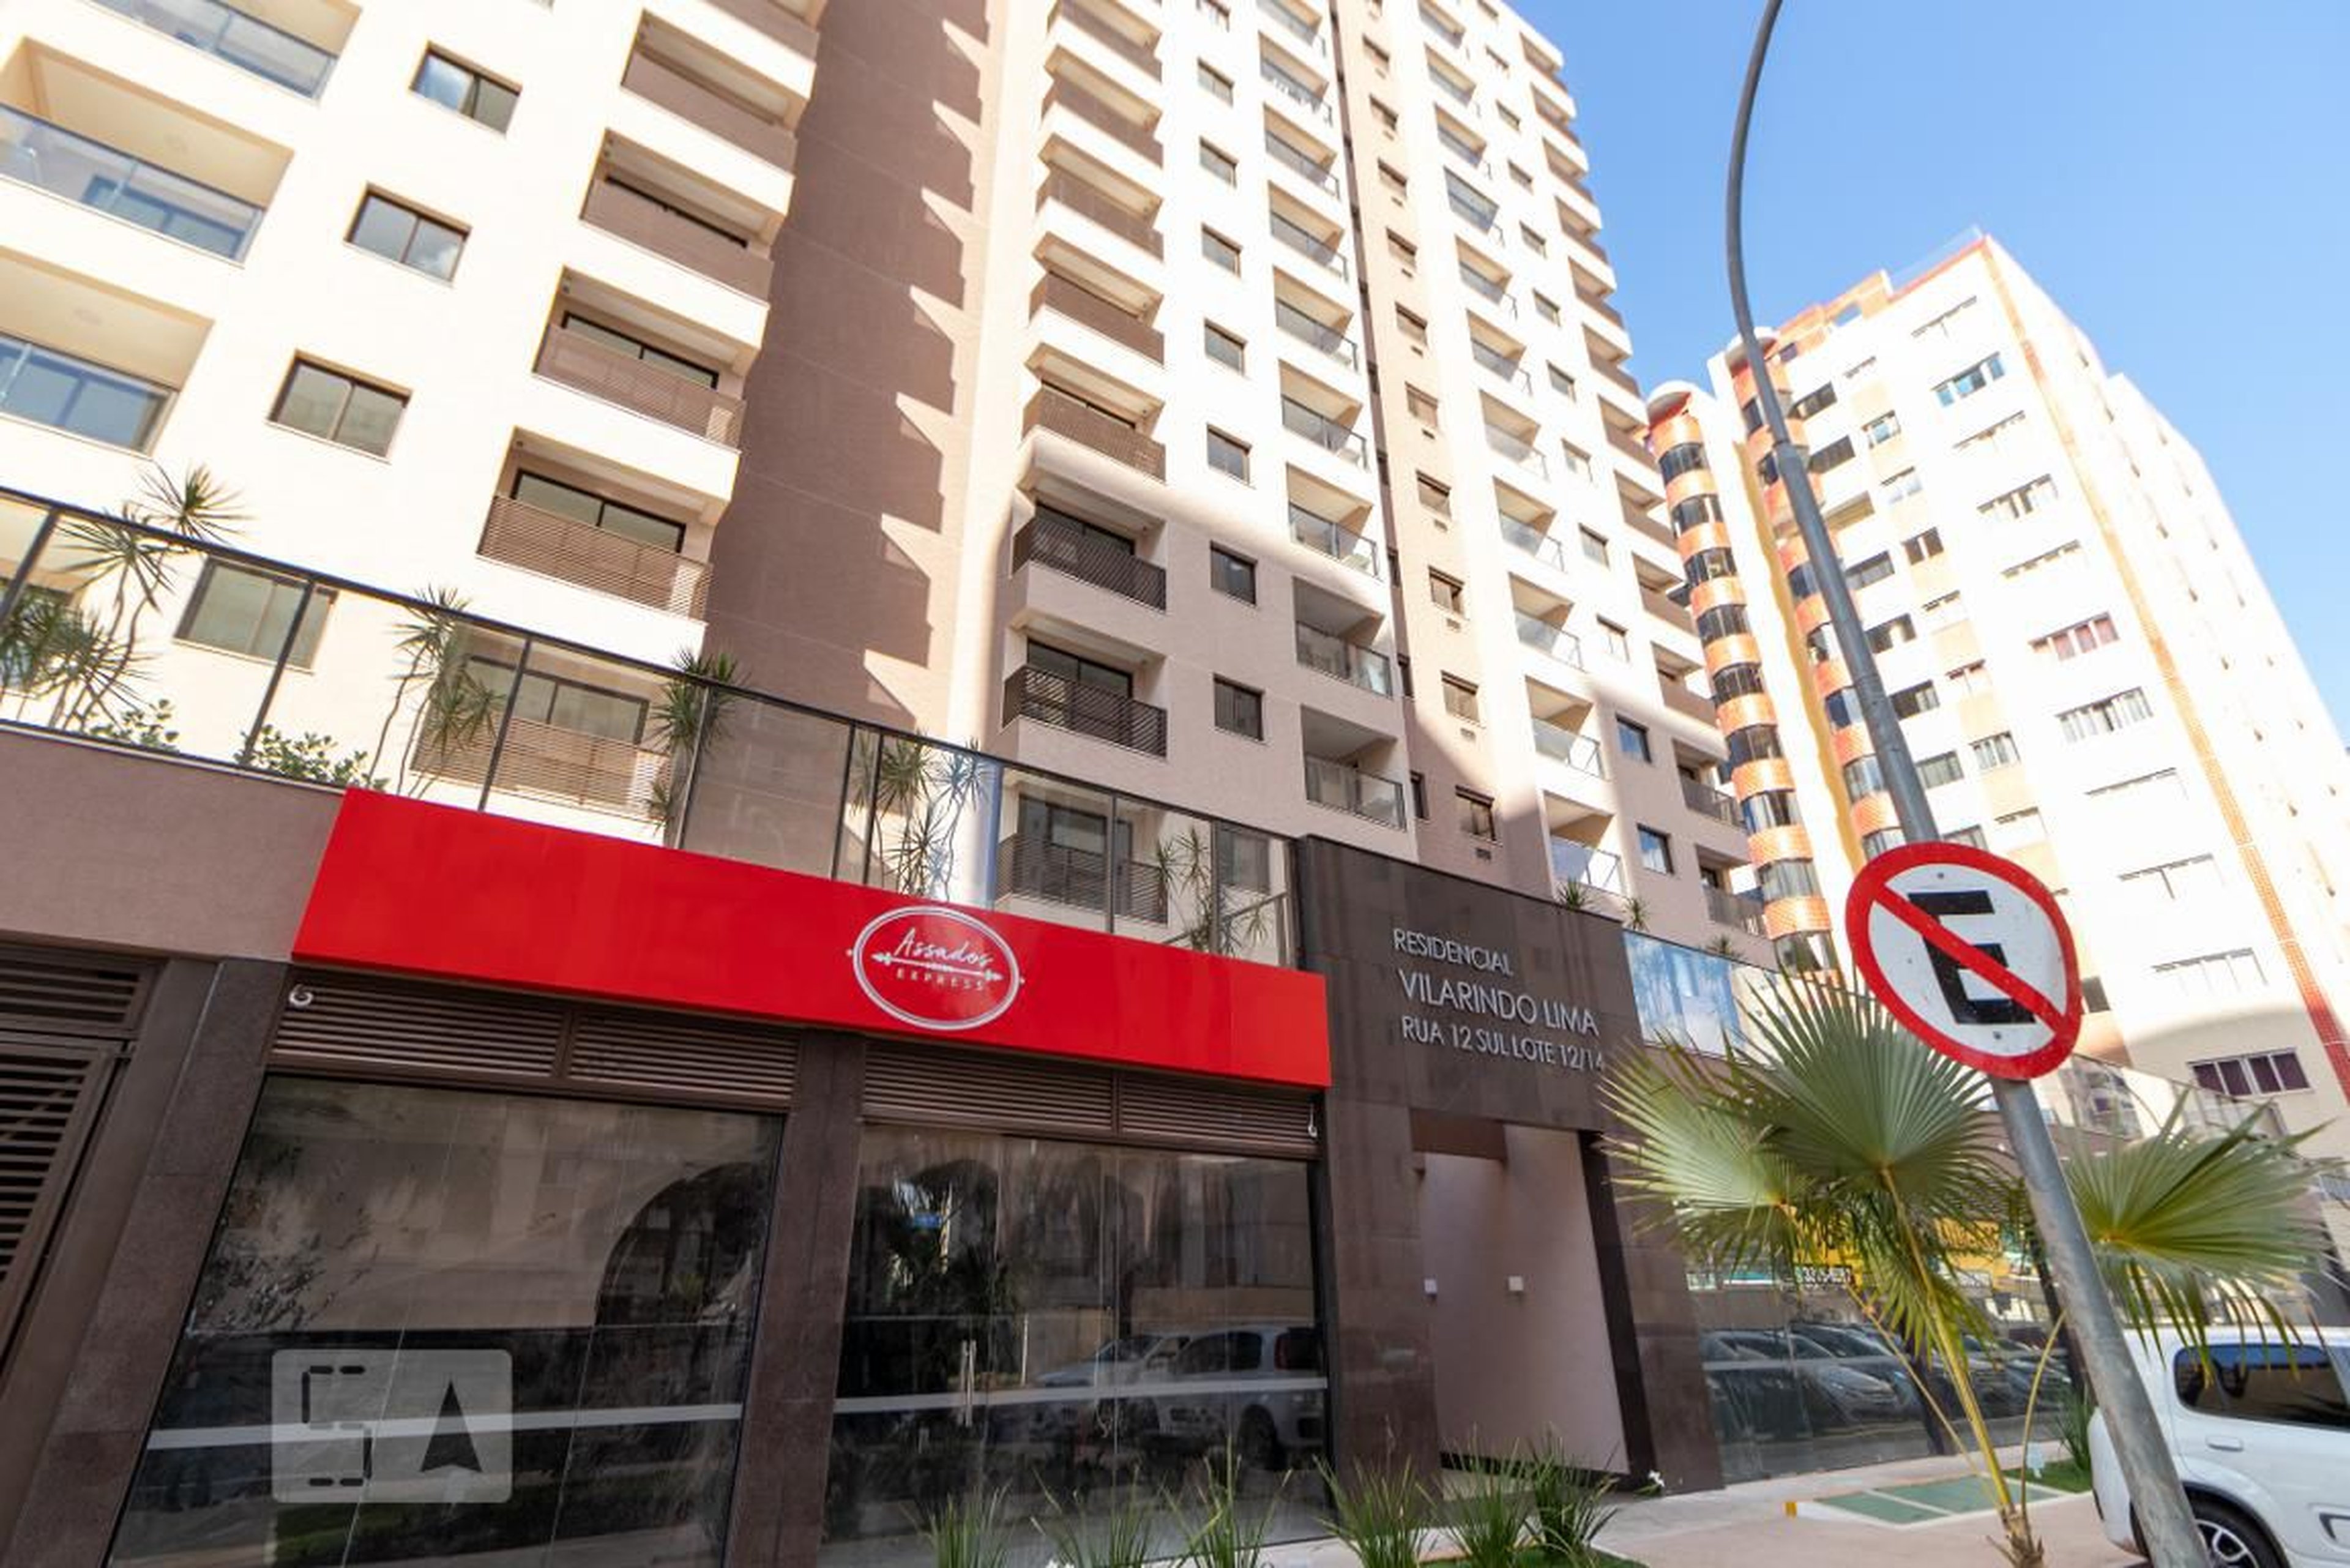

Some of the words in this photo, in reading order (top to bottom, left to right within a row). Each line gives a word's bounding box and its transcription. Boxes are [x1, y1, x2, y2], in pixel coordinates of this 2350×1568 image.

[893, 927, 993, 967] Assados
[1393, 928, 1514, 976] RESIDENCIAL
[1908, 890, 2036, 1024] E
[896, 968, 985, 991] EXPRESS
[1398, 968, 1538, 1025] VILARINDO
[1542, 999, 1600, 1037] LIMA
[1401, 1015, 1444, 1047] RUA
[1451, 1025, 1472, 1051] 12
[1476, 1028, 1508, 1055] SUL
[1512, 1037, 1554, 1064] LOTE
[1560, 1045, 1605, 1072] 12/14
